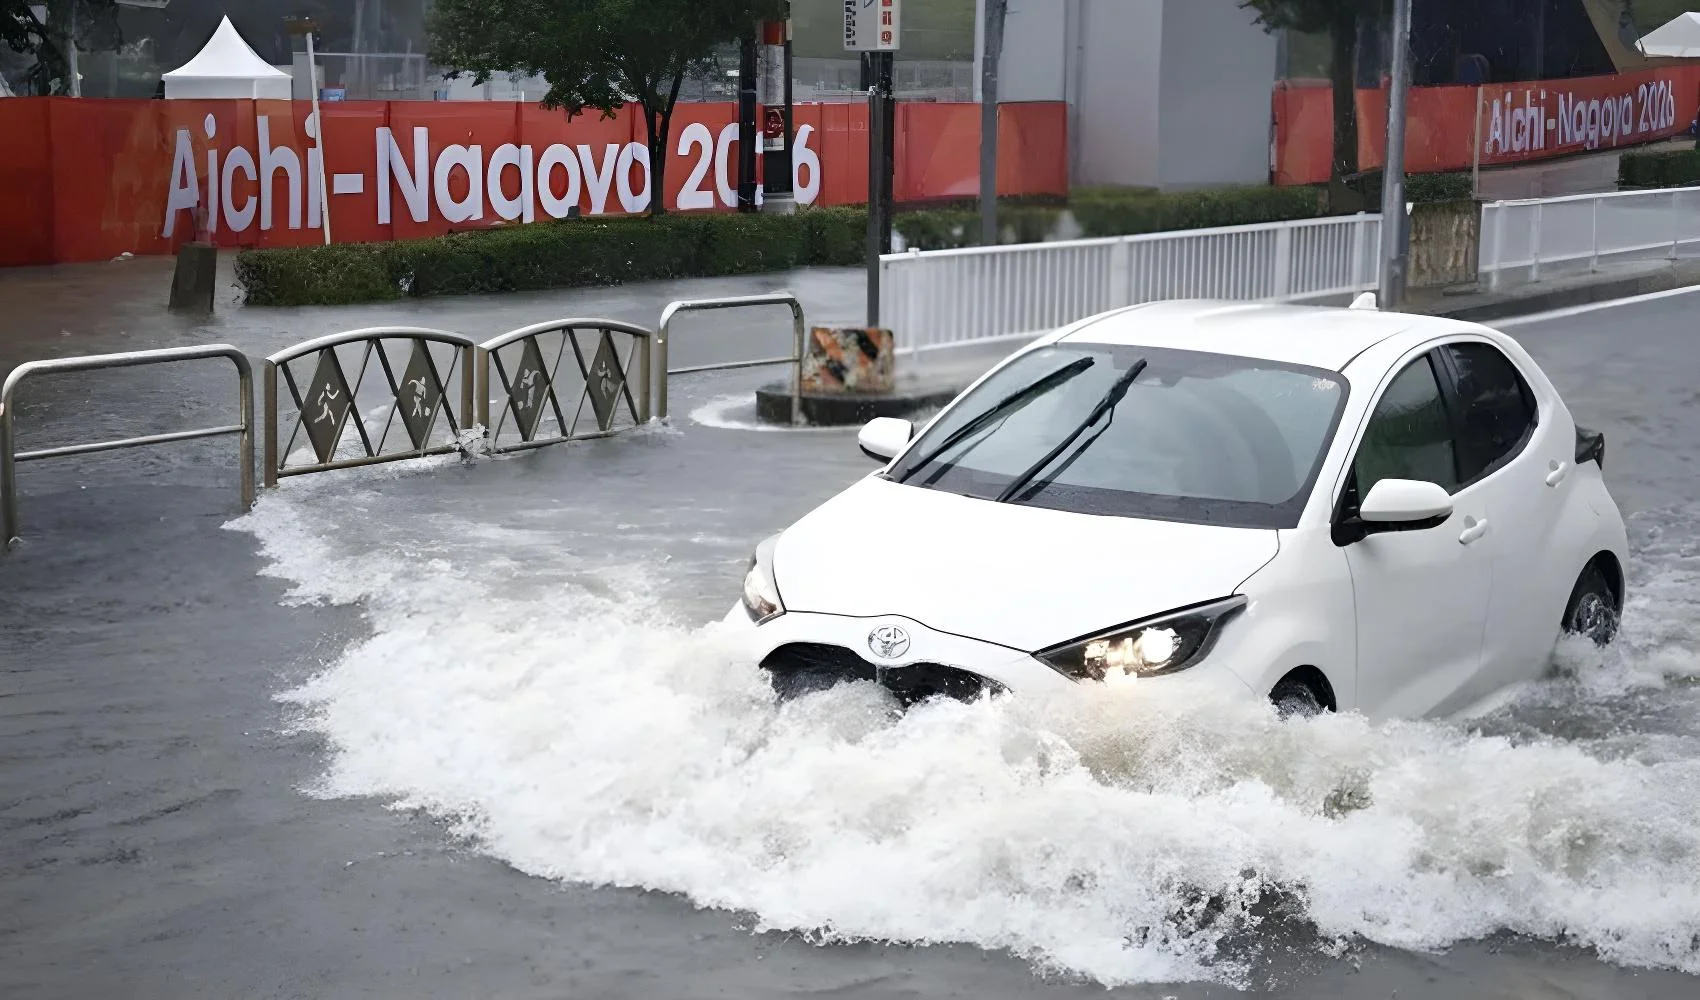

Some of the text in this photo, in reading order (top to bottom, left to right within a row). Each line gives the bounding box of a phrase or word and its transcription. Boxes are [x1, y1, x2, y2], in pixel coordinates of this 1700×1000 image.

[1485, 80, 1675, 153] Aichi-Nagoya 2026
[676, 122, 821, 209] 206
